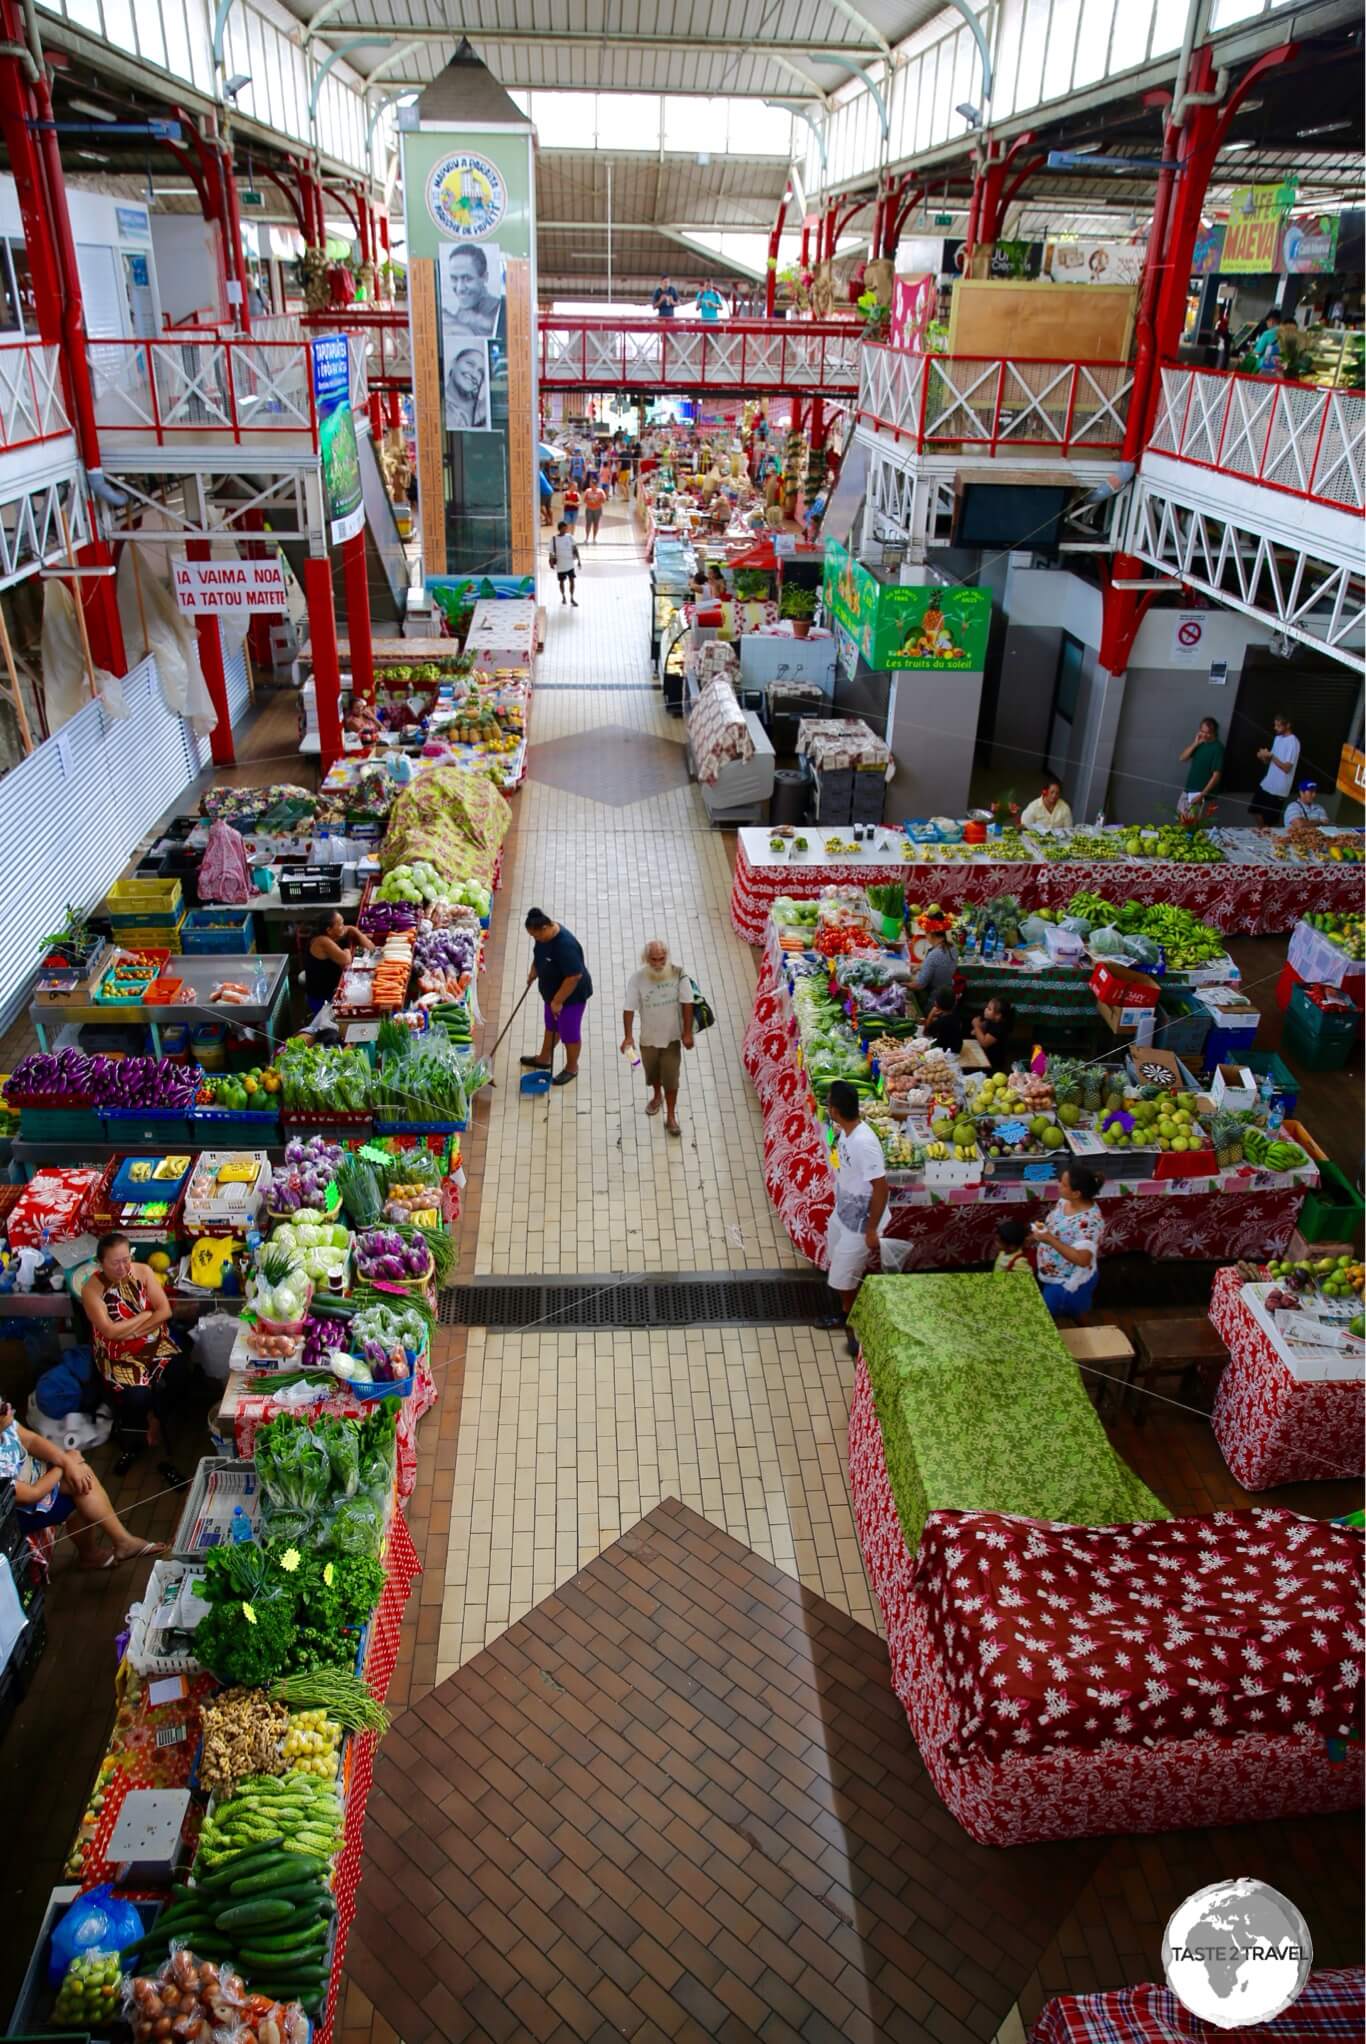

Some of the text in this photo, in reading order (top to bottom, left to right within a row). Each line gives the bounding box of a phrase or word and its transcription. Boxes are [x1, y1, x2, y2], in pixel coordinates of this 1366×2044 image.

[1223, 221, 1277, 260] MAEVA
[176, 569, 281, 585] IA VAIMA NOA
[179, 591, 286, 606] TA TATOU MATETE
[886, 659, 972, 669] Les fruits du soleil
